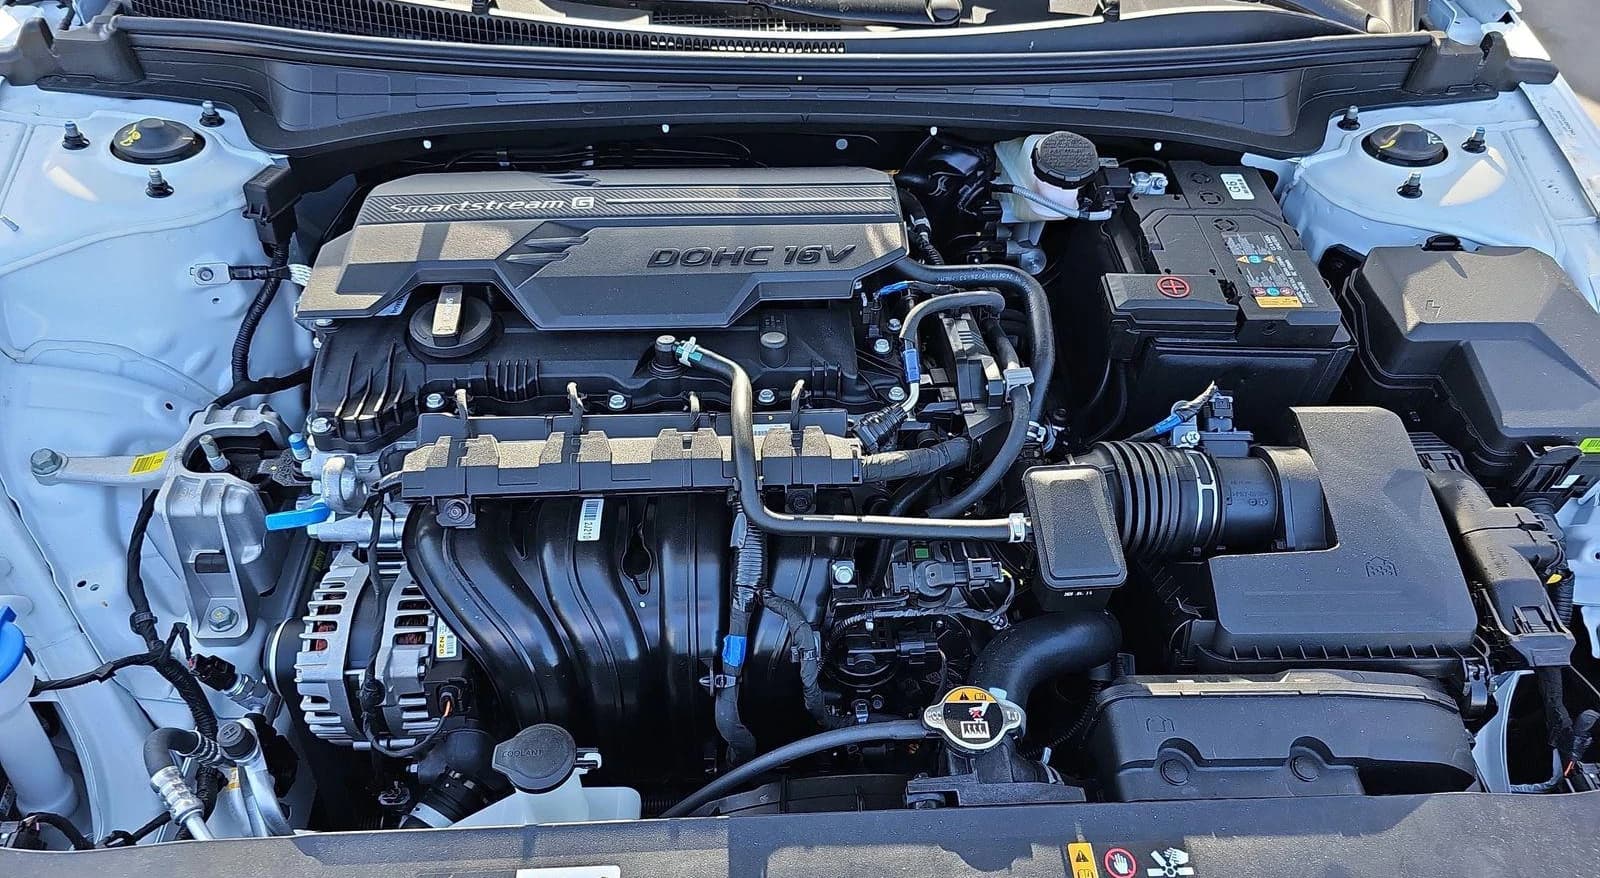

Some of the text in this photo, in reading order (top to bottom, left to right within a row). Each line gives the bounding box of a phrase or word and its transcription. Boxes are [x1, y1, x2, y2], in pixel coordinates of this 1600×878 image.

[385, 200, 564, 215] Smartstream
[647, 244, 857, 268] DOHC 16V
